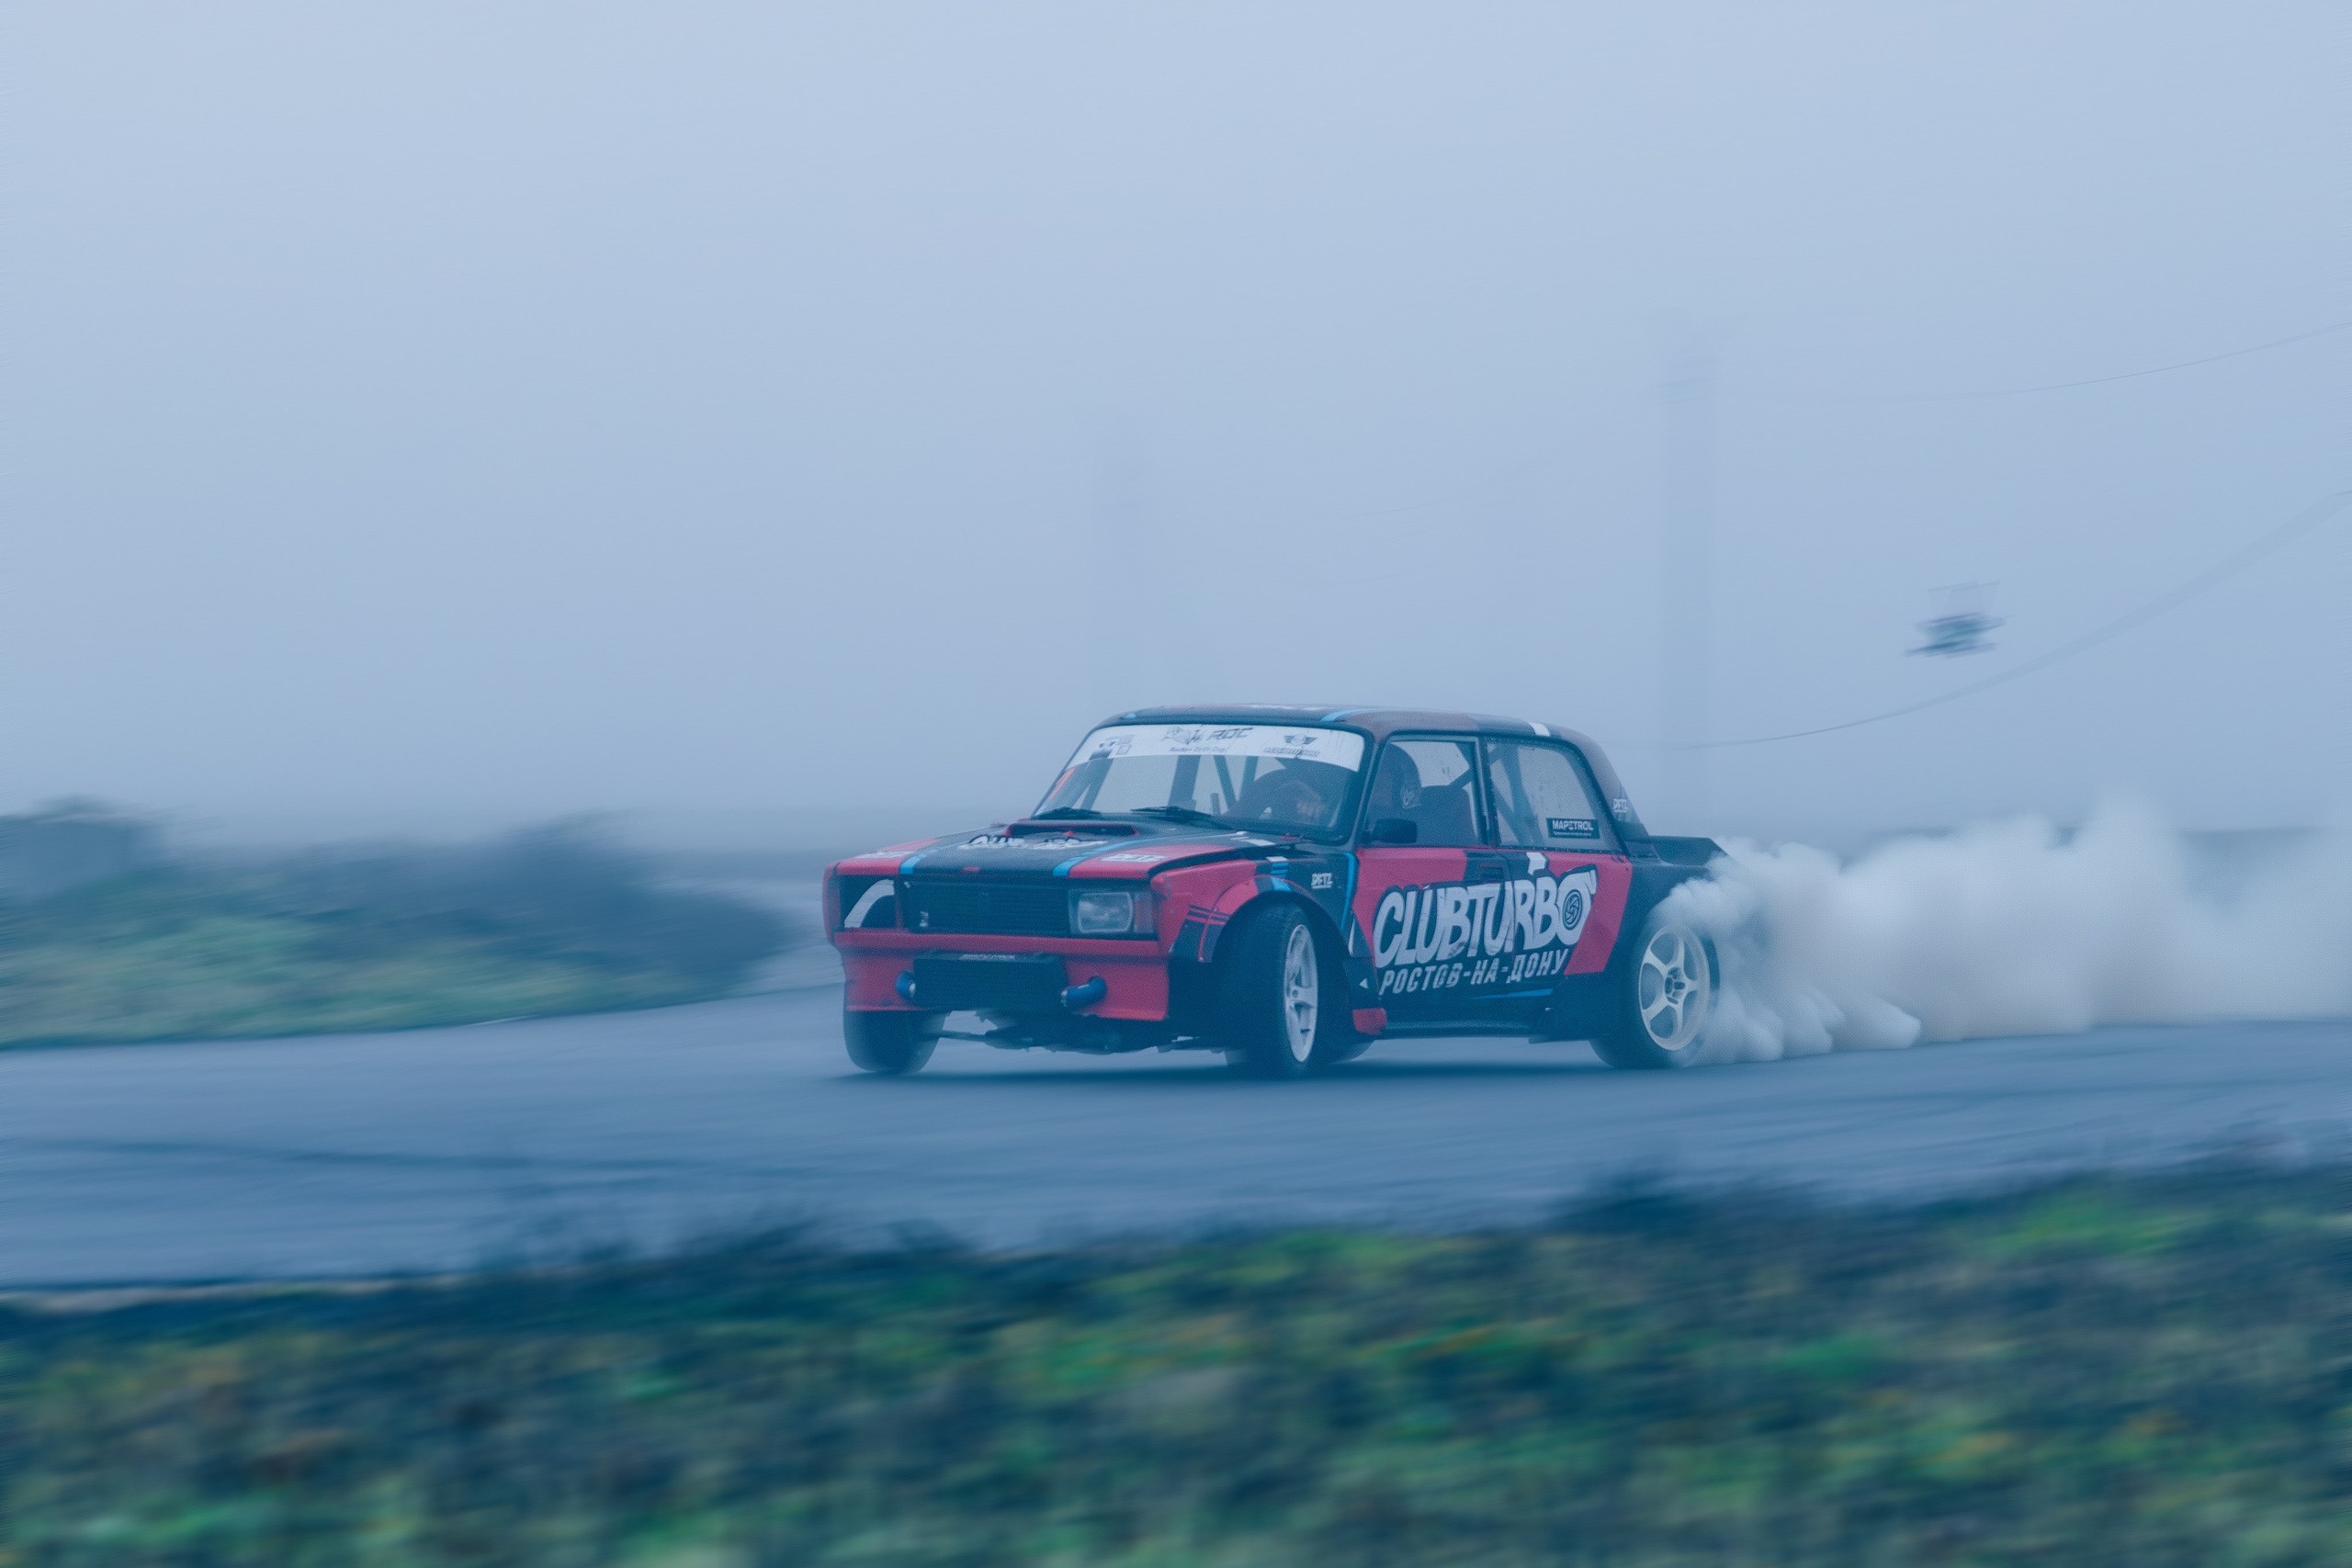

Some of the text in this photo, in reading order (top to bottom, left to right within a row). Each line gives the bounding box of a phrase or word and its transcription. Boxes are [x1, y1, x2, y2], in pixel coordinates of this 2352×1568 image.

[1552, 819, 1594, 830] MAPETROL
[1373, 870, 1598, 969] CLUBTURBO
[1378, 948, 1570, 996] РОСТОВ-НА-ДОНУ
